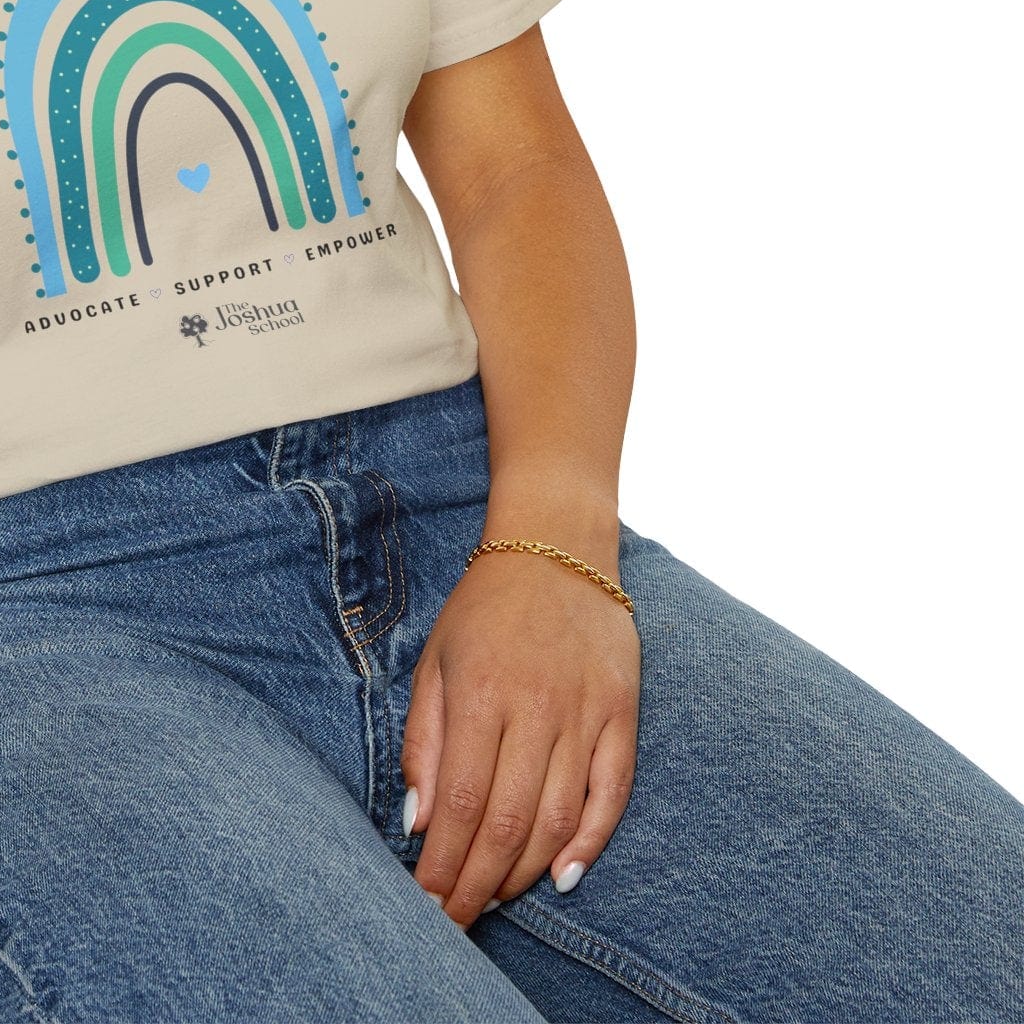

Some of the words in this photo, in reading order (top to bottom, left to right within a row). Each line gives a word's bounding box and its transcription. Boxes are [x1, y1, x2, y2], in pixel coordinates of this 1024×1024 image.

[24, 293, 141, 334] ADVOCATE
[174, 258, 274, 295] SUPPORT
[305, 223, 398, 262] EMPOWER
[215, 299, 299, 331] Joshua
[224, 301, 249, 314] The
[248, 311, 305, 336] School
